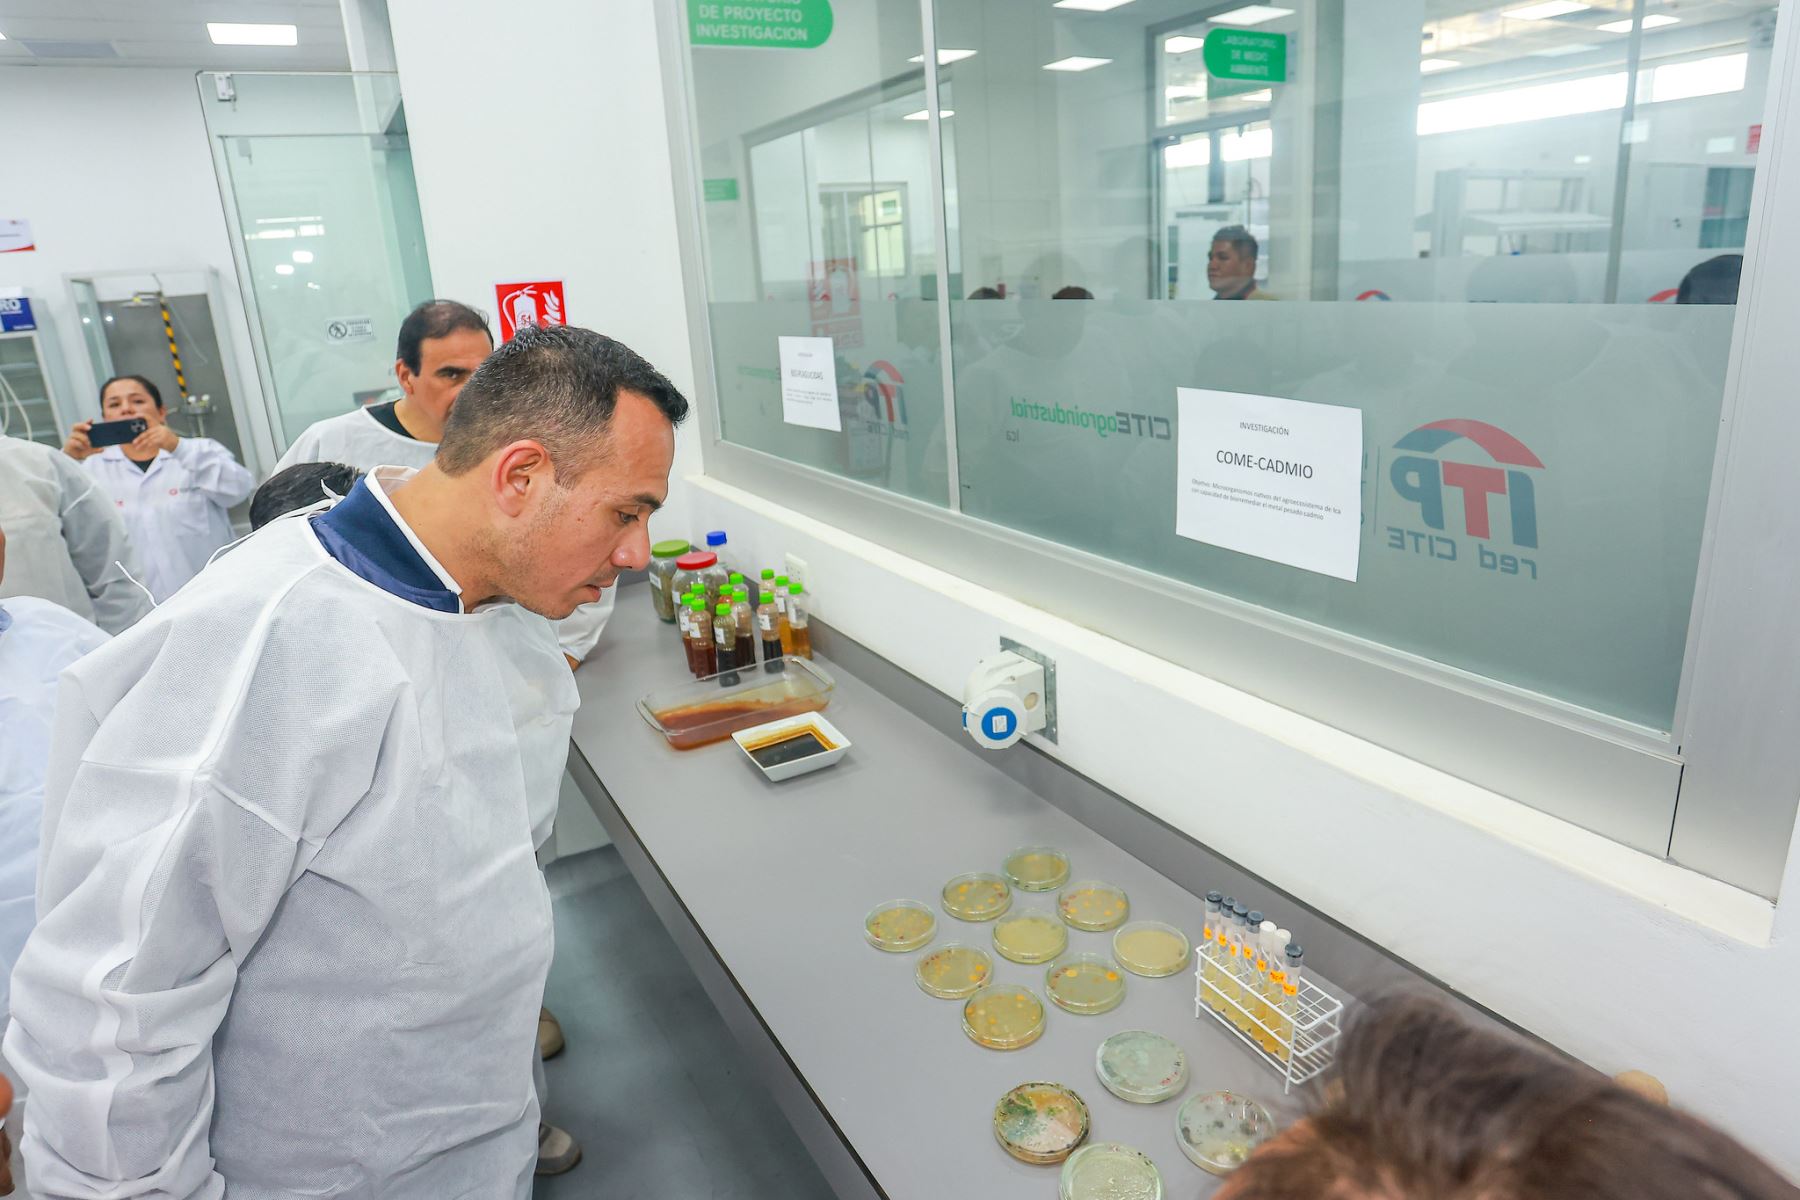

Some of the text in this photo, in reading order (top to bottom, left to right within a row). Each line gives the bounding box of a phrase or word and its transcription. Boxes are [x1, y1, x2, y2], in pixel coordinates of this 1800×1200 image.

[699, 4, 803, 24] DE PROYECTO
[696, 22, 809, 42] INVESTIGACION
[1239, 421, 1290, 436] INVESTIGACIÓN
[1215, 449, 1314, 479] COME-CADMIO
